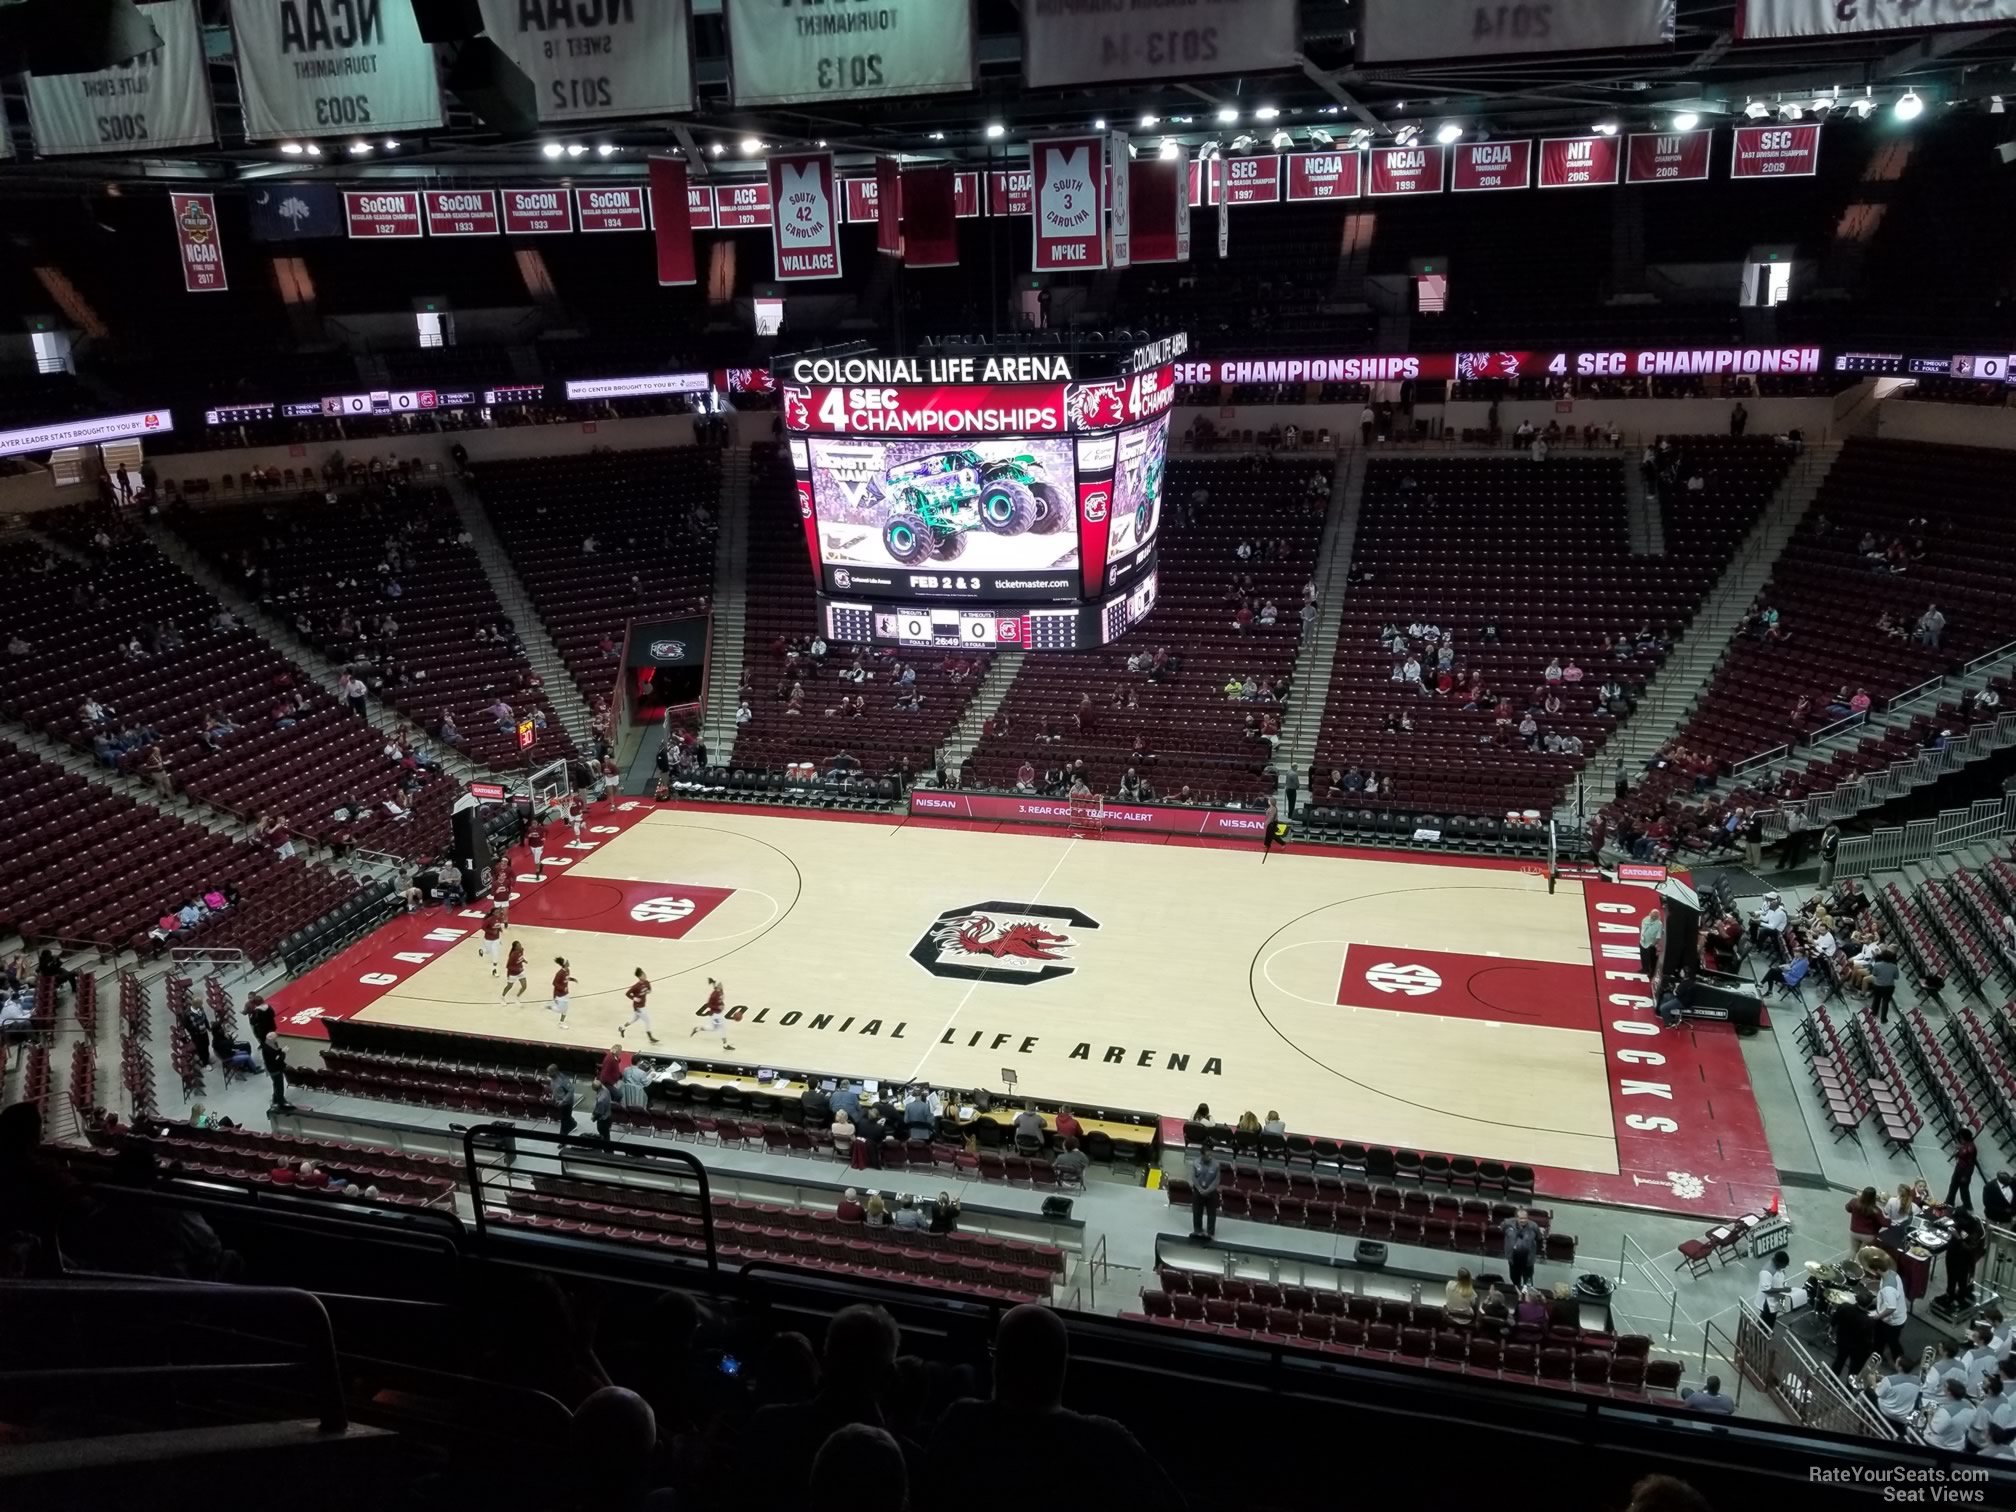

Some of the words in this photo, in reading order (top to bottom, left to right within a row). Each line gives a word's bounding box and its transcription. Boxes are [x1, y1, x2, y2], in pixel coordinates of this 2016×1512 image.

[1656, 136, 1682, 155] NIT
[1761, 131, 1792, 150] SEC
[1472, 145, 1512, 164] NCAA
[1567, 142, 1593, 160] NIT
[1305, 156, 1343, 174] NCAA
[1387, 151, 1426, 169] NCAA
[1762, 163, 1785, 173] 2009
[1232, 161, 1257, 178] SEC
[1568, 172, 1590, 182] 2005
[1053, 179, 1084, 193] SOUTH
[1480, 176, 1501, 186] 2004
[734, 189, 757, 204] ACC
[862, 182, 878, 198] NC
[1234, 190, 1253, 199] 1997
[1314, 186, 1333, 195] 1997
[360, 197, 405, 213] SoCON
[438, 195, 483, 211] SoCON
[516, 194, 557, 209] SoCON
[590, 192, 630, 207] SoCON
[789, 192, 816, 206] SOUTH
[1064, 194, 1073, 210] 3
[796, 207, 812, 222] 42
[1008, 203, 1026, 212] 1973
[454, 222, 474, 231] 1933
[530, 221, 548, 229] 1933
[604, 219, 622, 228] 1934
[739, 215, 755, 223] 1970
[1046, 209, 1090, 228] CAROLINA
[376, 224, 395, 233] 1927
[785, 221, 825, 239] CAROLINA
[185, 244, 218, 262] NCAA
[782, 253, 834, 271] WALLACE
[198, 273, 214, 284] 2017
[1134, 345, 1161, 373] COLONIAL
[1550, 354, 1566, 376] 4
[1577, 352, 1626, 375] SEC
[1637, 349, 1820, 374] CHAMPIONSH
[794, 359, 922, 384] COLONIAL
[931, 358, 973, 383] LIFE
[983, 356, 1072, 382] ARENA
[1174, 363, 1211, 384] SEC
[1221, 357, 1419, 384] CHAMPIONSHIPS
[1984, 360, 1998, 376] 0
[1141, 371, 1158, 395] SEC
[352, 399, 363, 411] 0
[399, 395, 409, 408] 0
[849, 388, 900, 410] SEC
[1129, 376, 1141, 420] 4
[818, 388, 849, 431] 4
[851, 407, 1057, 432] CHAMPIONSHIPS
[0, 439, 20, 448] AYER
[21, 435, 49, 445] LEADER
[51, 432, 72, 441] STATS
[73, 427, 105, 437] BROUGHT
[910, 576, 938, 588] FEB
[942, 577, 952, 589] 2
[956, 577, 967, 589] &
[971, 577, 980, 589] 3
[995, 579, 1069, 589] ticketmaster.com
[909, 620, 921, 636] 0
[972, 622, 985, 638] 0
[935, 637, 959, 646] 26:49
[522, 730, 533, 746] 30
[916, 798, 956, 809] NISSAN
[1019, 805, 1027, 813] 3.
[1028, 806, 1051, 815] REAR
[1086, 810, 1122, 819] TRAFFIC
[1124, 812, 1153, 821] ALERT
[1219, 818, 1264, 831] NISSAN
[630, 897, 695, 923] SEC
[1365, 962, 1442, 996] SEC
[1595, 902, 1678, 1133] GAMECOCKS
[696, 1005, 907, 1038] COLONIAL
[940, 1027, 1039, 1053] LIFE
[1068, 1042, 1222, 1076] ARENA
[1757, 1228, 1787, 1256] DEFENSE
